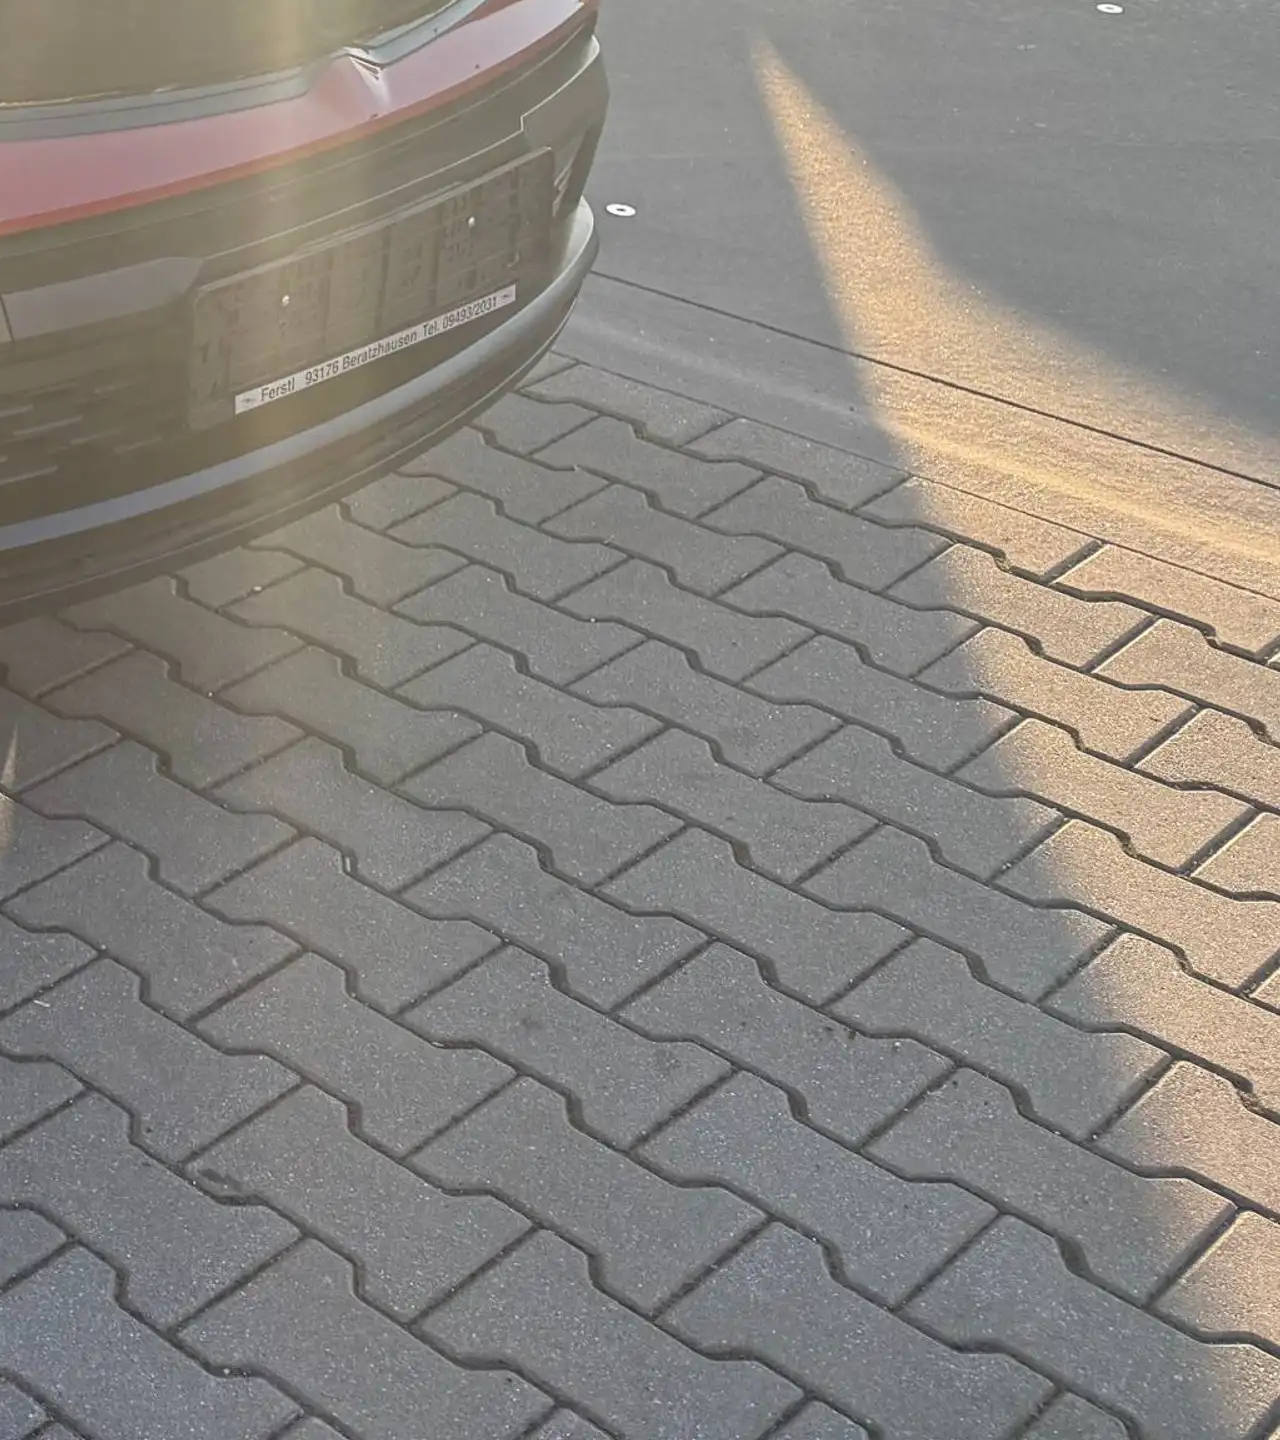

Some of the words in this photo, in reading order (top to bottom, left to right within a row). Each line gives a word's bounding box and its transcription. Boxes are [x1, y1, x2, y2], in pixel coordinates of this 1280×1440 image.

[260, 376, 295, 401] Ferstl
[305, 360, 339, 385] 93176
[342, 331, 417, 371] Beratzhausen
[423, 323, 440, 338] Tel.
